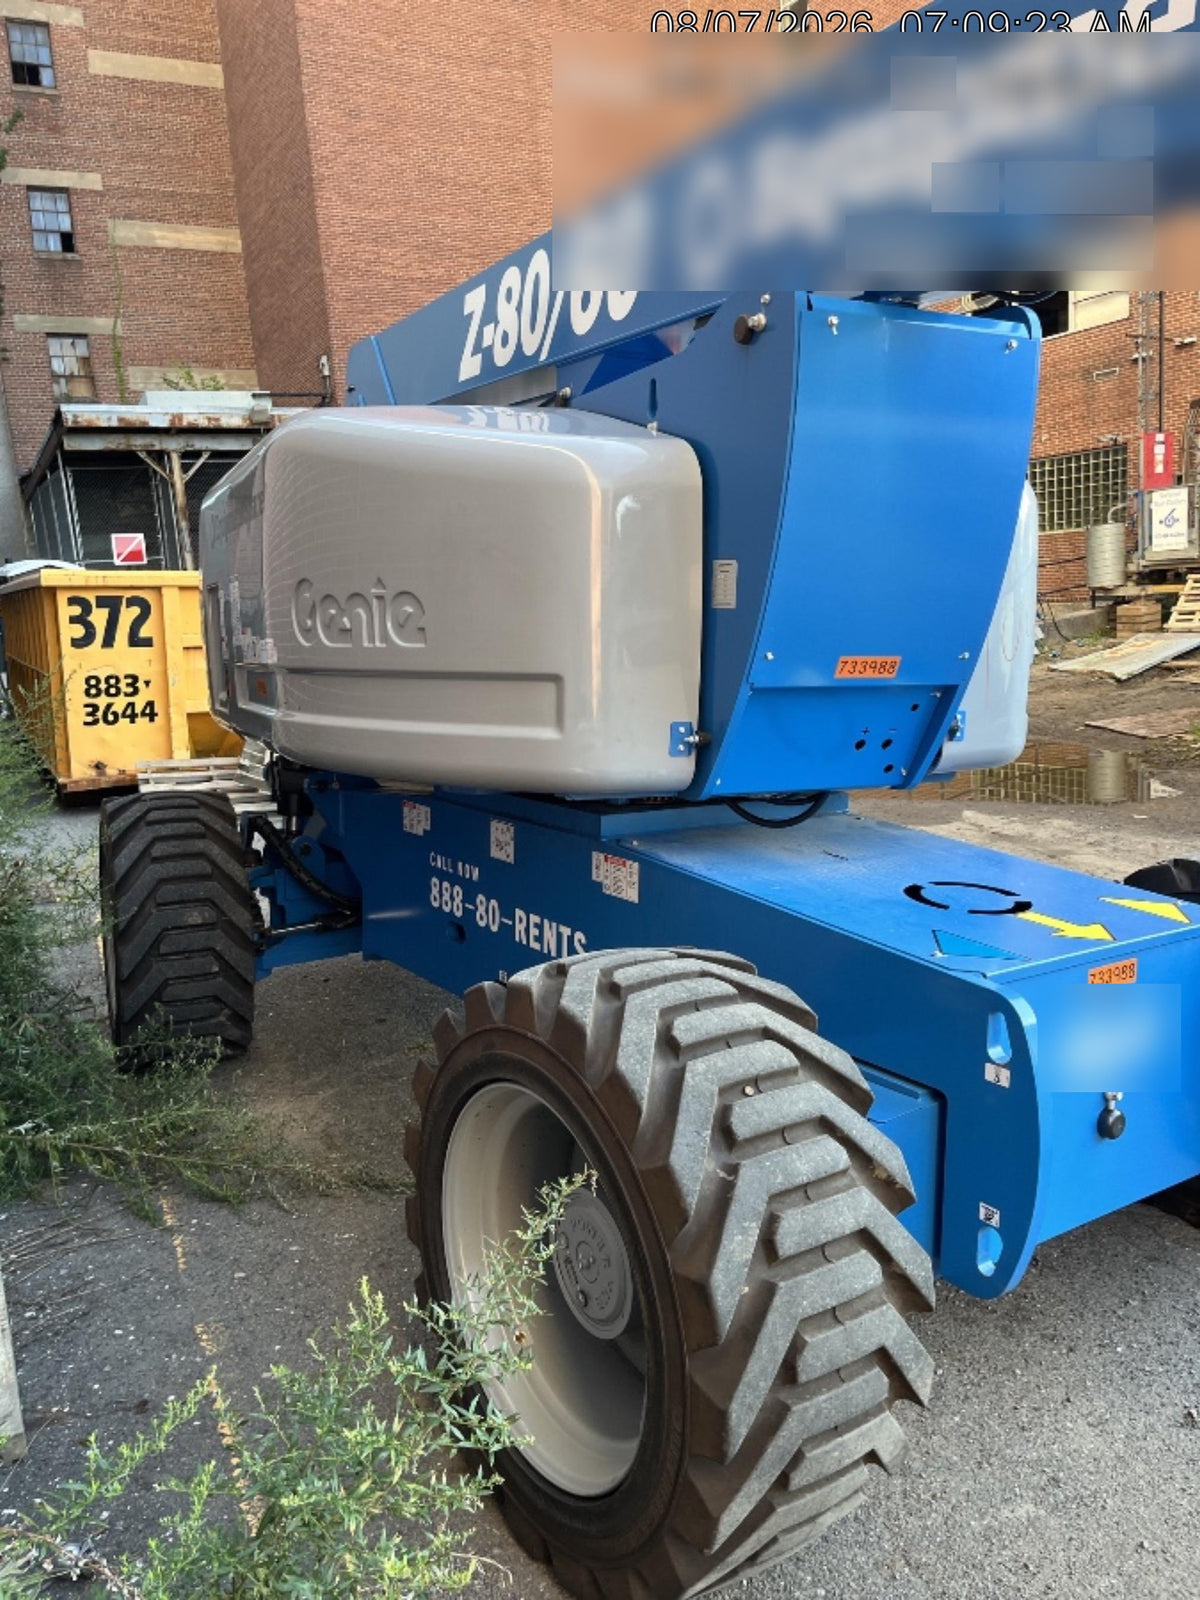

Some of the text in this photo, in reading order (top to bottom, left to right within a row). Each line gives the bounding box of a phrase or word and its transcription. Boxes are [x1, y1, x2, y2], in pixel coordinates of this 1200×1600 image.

[66, 595, 154, 649] 372
[291, 577, 426, 647] Genie
[838, 660, 897, 675] 733988
[82, 700, 158, 726] 3644
[429, 851, 479, 882] CALL NOW
[430, 876, 587, 959] 888-80-RENTS
